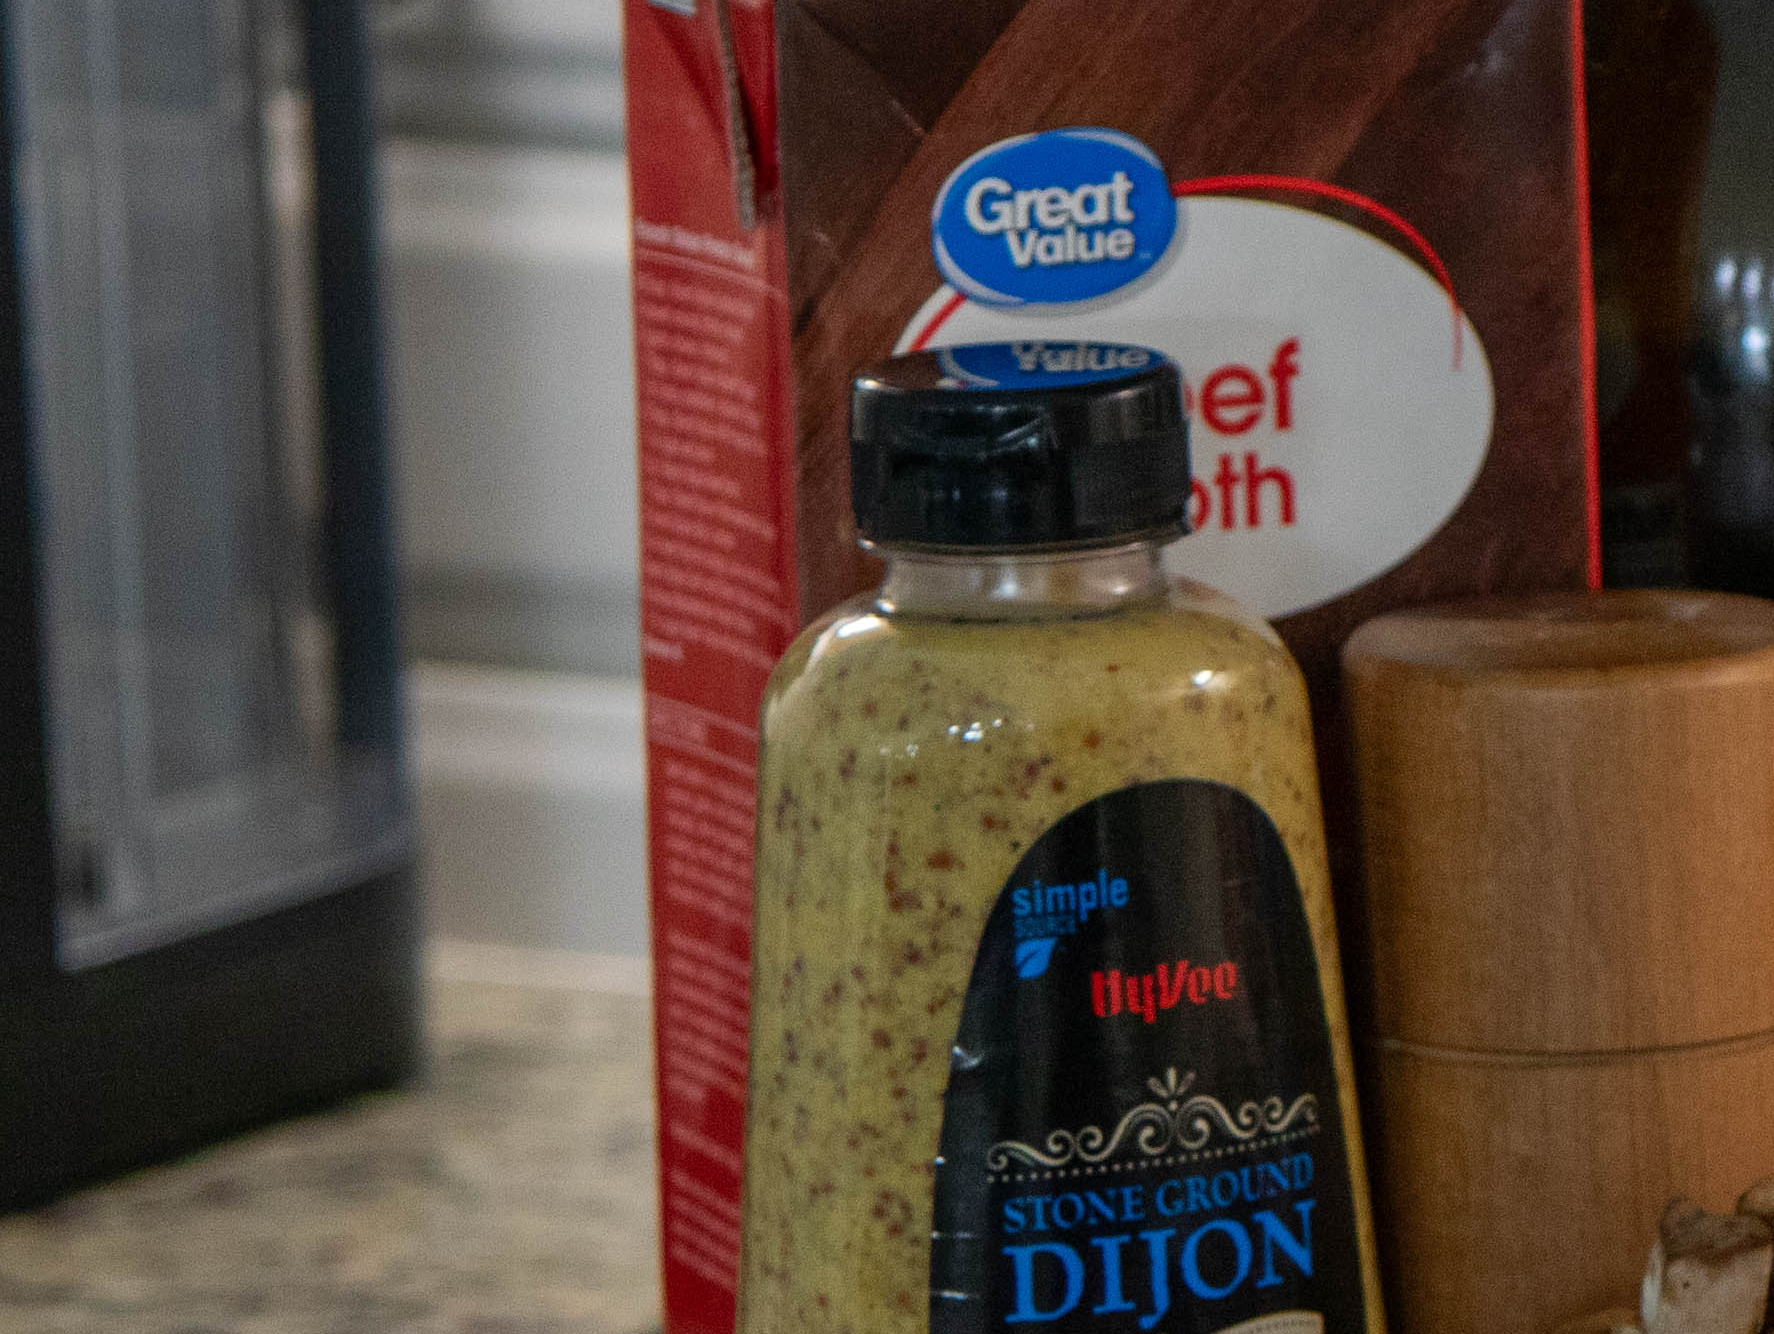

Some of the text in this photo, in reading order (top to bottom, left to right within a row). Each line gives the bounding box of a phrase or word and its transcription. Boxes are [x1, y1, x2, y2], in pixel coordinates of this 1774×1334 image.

[964, 171, 1135, 235] Great
[1006, 225, 1136, 268] Value
[1186, 337, 1300, 438] ef
[1012, 868, 1129, 922] simple
[1003, 1151, 1315, 1235] STONE GROUND
[1002, 1198, 1317, 1329] DIJON
